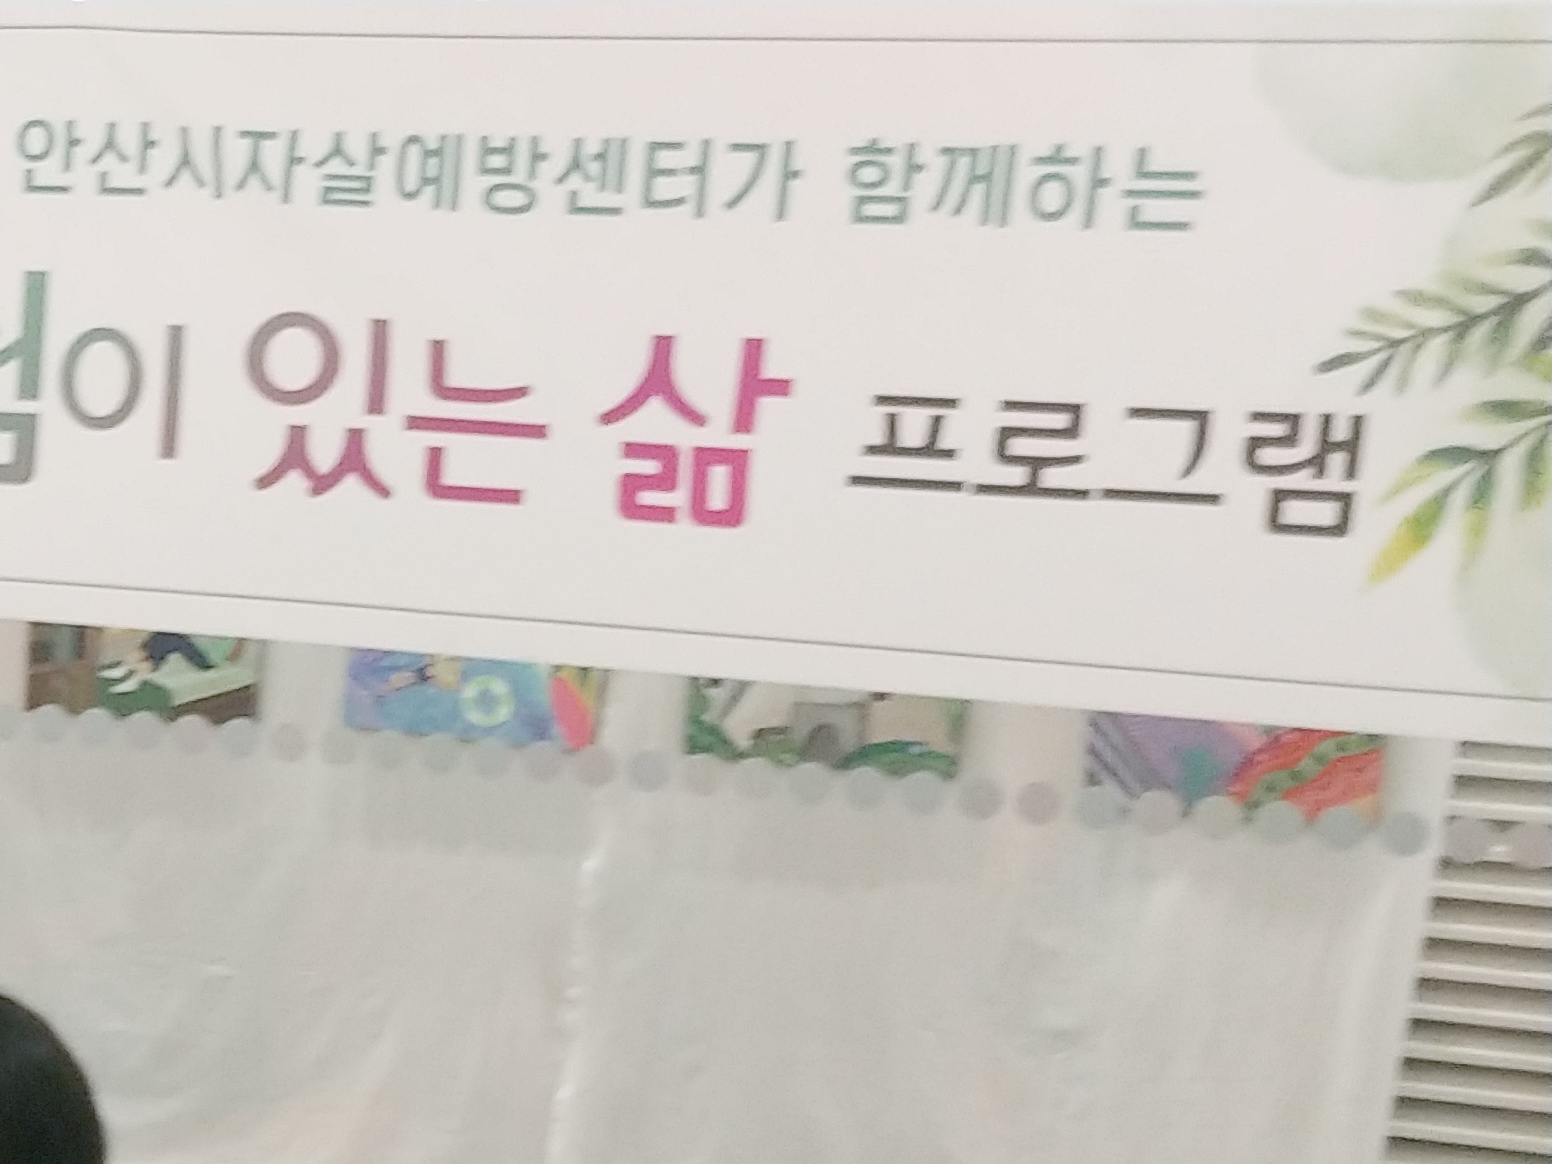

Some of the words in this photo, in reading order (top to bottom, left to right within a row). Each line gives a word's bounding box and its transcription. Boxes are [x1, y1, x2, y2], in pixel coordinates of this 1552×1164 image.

[15, 115, 808, 222] 안산시자살예방센터가
[845, 135, 1207, 232] 함께하는
[245, 310, 550, 506] 있는
[598, 333, 795, 530] 삶
[845, 394, 1368, 538] 프로그램
